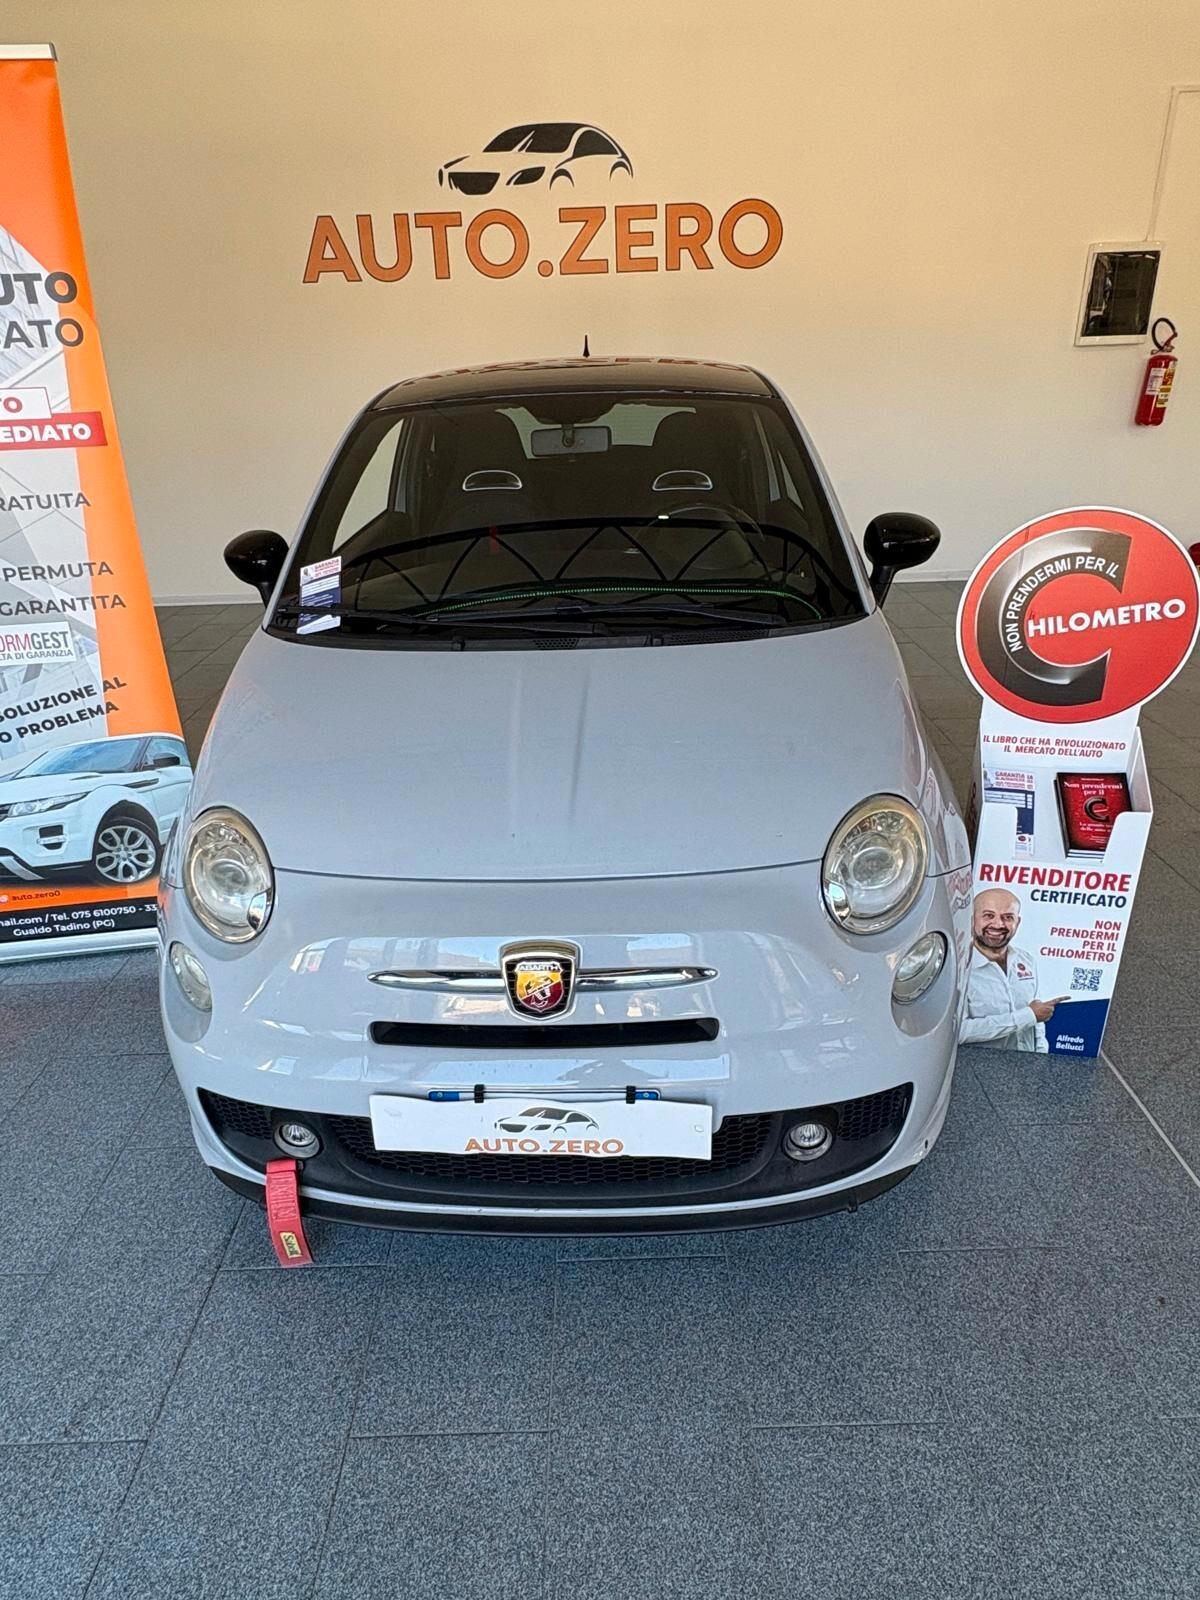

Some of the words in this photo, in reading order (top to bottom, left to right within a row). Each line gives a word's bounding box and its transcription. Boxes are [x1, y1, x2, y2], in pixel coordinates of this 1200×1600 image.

[303, 198, 783, 283] AUTO.ZERO
[0, 318, 84, 349] ATO
[2, 561, 114, 582] PERMUTA
[1075, 556, 1106, 570] PER
[1106, 562, 1119, 579] IL
[1006, 558, 1071, 619] PRENDERMI
[0, 594, 127, 617] GARANTITA
[1005, 623, 1023, 652] NON
[15, 652, 25, 660] DI
[26, 649, 74, 659] GARANZIA
[102, 676, 128, 693] AL
[15, 702, 119, 738] PROBLEMA
[983, 735, 990, 743] IL
[992, 735, 1018, 745] LIBRO
[1019, 736, 1037, 746] CHE
[1038, 738, 1051, 746] HA
[1054, 739, 1126, 751] RIVOLUZIONATO
[1003, 745, 1012, 753] IL
[1014, 746, 1056, 756] MERCATO
[1057, 748, 1104, 758] DELL'AUTO
[980, 863, 1132, 892] RIVENDITORE
[1030, 889, 1127, 909] CERTIFICATO
[51, 912, 70, 922] Tel.
[71, 910, 91, 920] 075
[93, 905, 136, 917] 6100750
[13, 926, 52, 937] Gualdo
[53, 921, 91, 933] Tadino
[92, 918, 116, 930] (PG)
[1050, 927, 1119, 941] PRENDERMI
[1094, 920, 1121, 931] NON
[1082, 940, 1105, 950] PER
[1106, 943, 1117, 951] IL
[1039, 946, 1115, 963] CHILOMETRO
[1055, 1042, 1084, 1051] Bellucci
[1056, 1034, 1084, 1044] Alfredo
[464, 1138, 624, 1154] AUTO.ZERO
